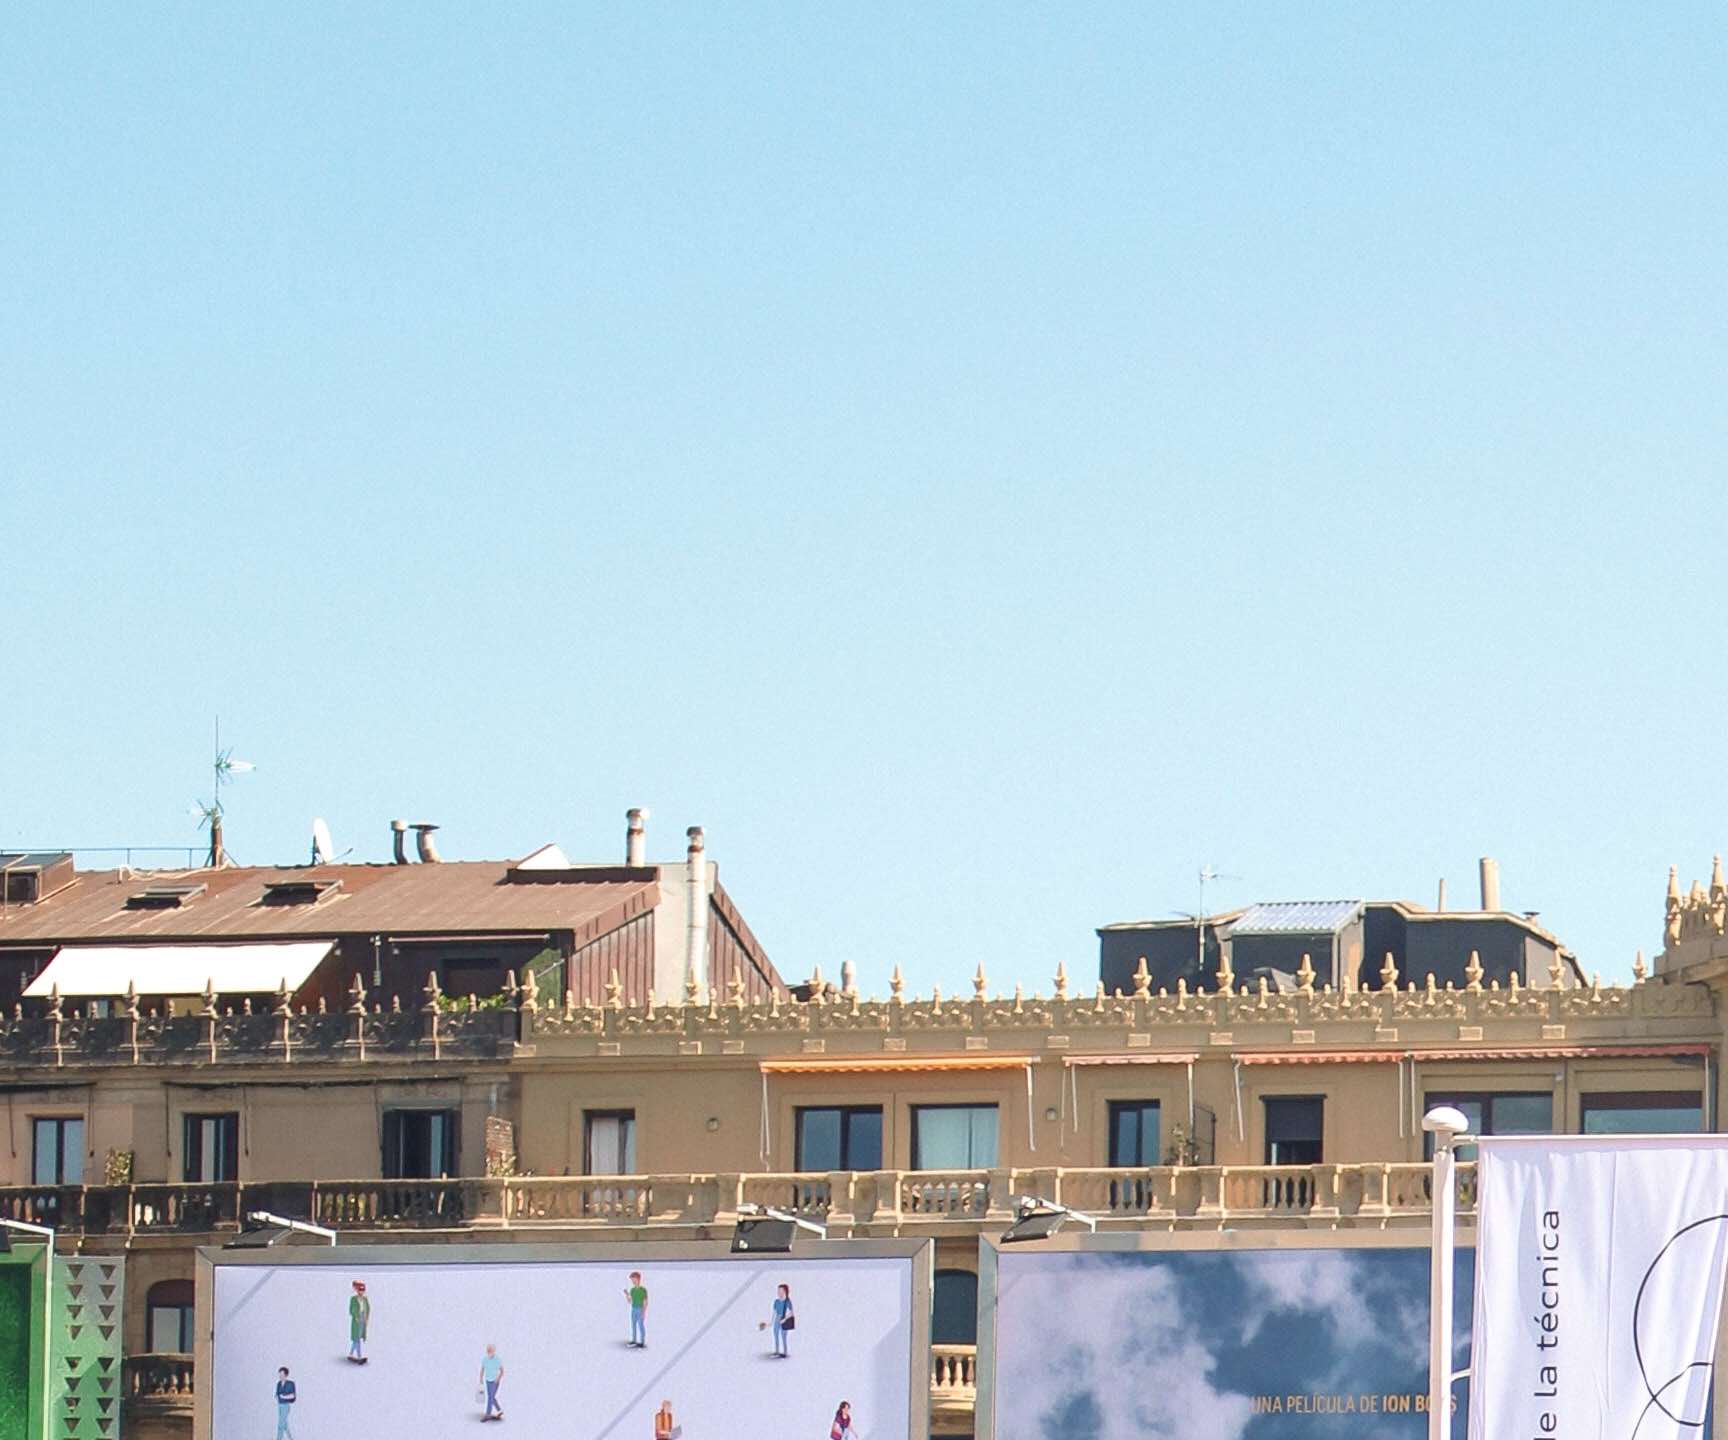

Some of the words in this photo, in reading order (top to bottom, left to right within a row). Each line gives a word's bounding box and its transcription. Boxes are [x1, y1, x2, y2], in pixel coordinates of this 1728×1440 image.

[1533, 1209, 1561, 1351] técnica
[1533, 1365, 1558, 1397] la
[1251, 1395, 1282, 1414] UNA
[1286, 1392, 1355, 1413] PELÍCULA
[1360, 1394, 1379, 1413] DE
[1382, 1394, 1410, 1413] ION
